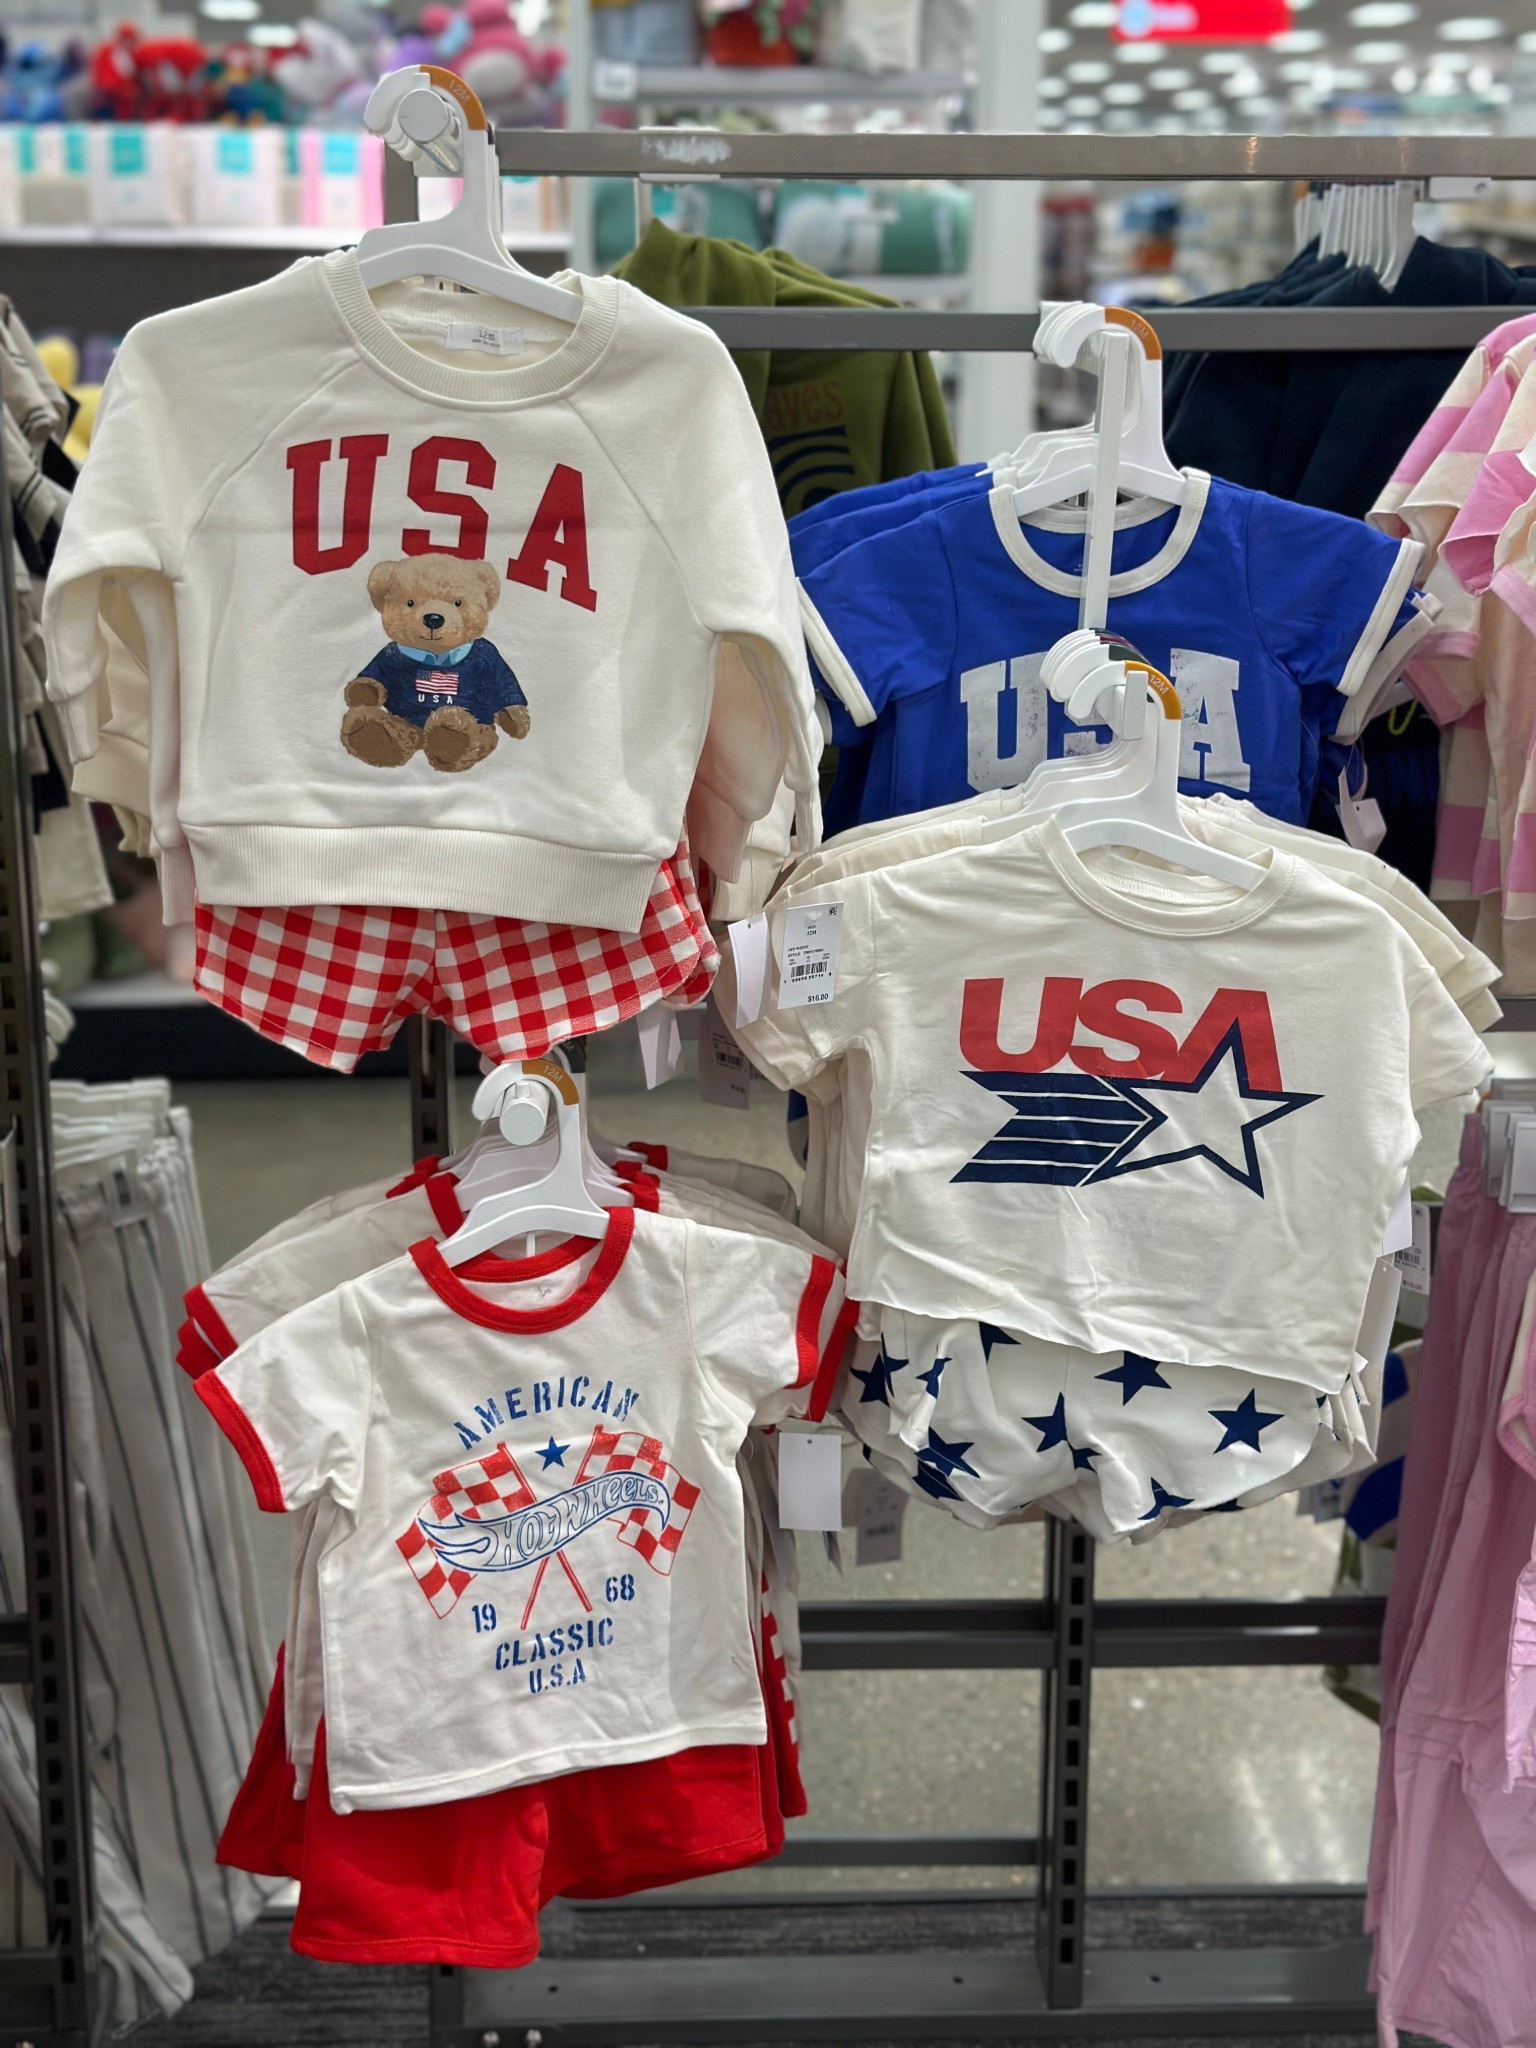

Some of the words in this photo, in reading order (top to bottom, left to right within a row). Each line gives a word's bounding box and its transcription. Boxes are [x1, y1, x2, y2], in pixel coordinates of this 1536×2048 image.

[478, 329, 495, 341] 12m
[766, 380, 844, 432] aves
[286, 433, 598, 612] USA
[1150, 674, 1169, 695] 12M
[960, 647, 1251, 794] UA
[807, 993, 829, 1002] $16.00
[959, 976, 1283, 1093] USA
[544, 1065, 564, 1083] 12M
[453, 1375, 640, 1451] AMERICAN
[471, 1603, 498, 1633] 19
[605, 1573, 636, 1603] 68
[494, 1617, 614, 1671] CLASSIC
[528, 1657, 587, 1694] U.S.A
